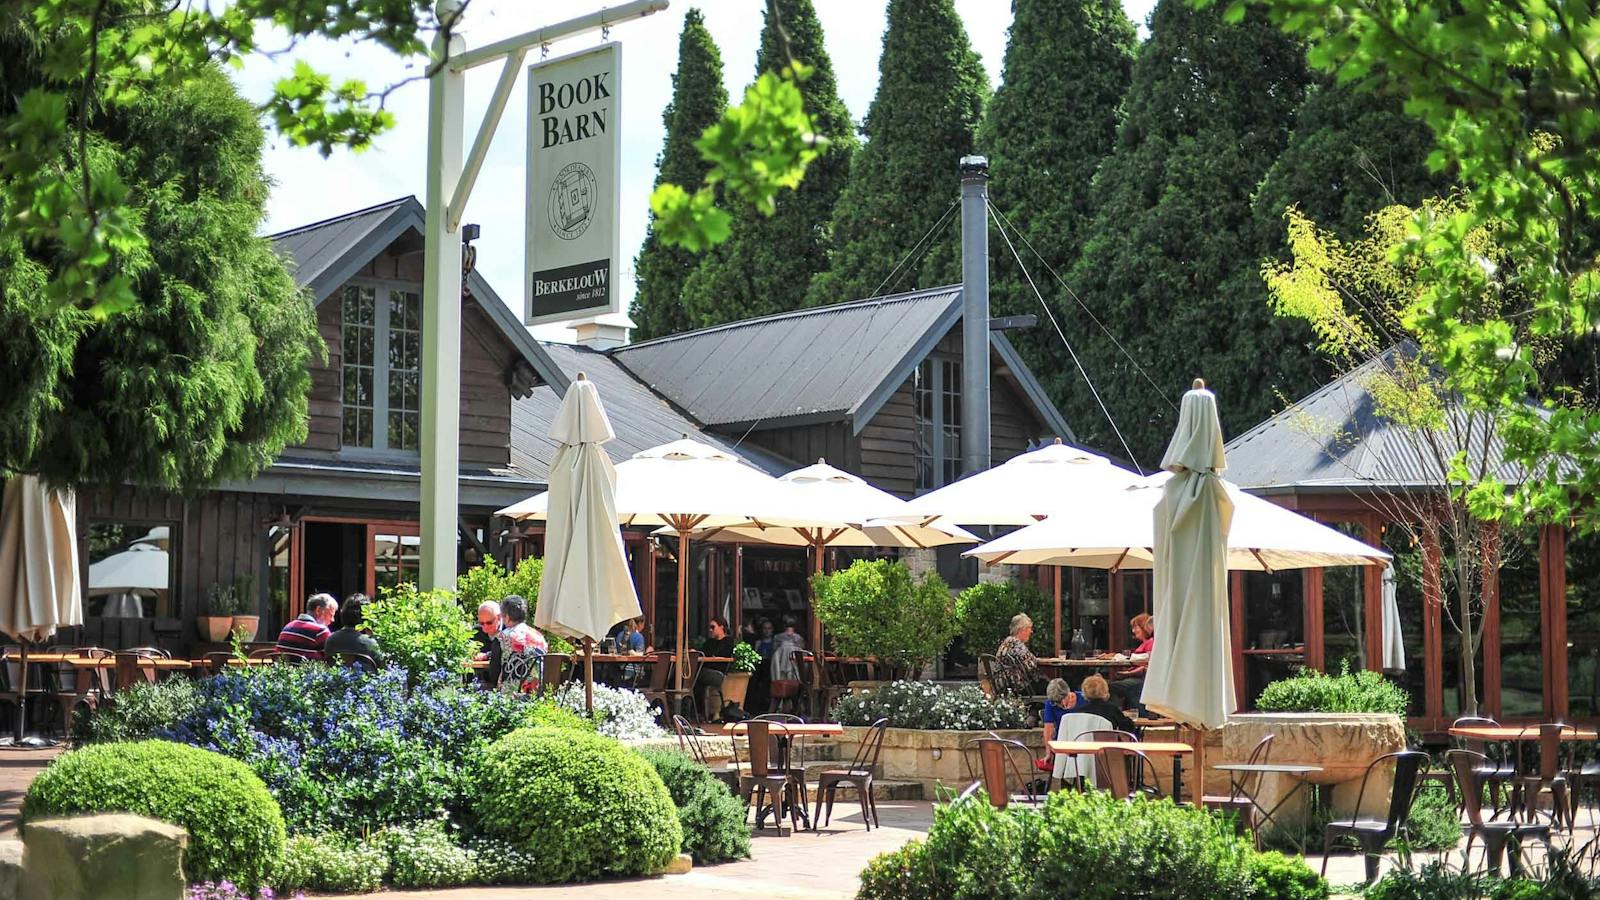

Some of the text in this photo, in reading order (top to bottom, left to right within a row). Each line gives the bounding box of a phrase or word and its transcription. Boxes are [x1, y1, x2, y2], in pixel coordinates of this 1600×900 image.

[538, 72, 610, 115] BOOK
[541, 108, 607, 149] BARN
[535, 268, 608, 296] BERKELOUW
[575, 287, 606, 301] since 1812
